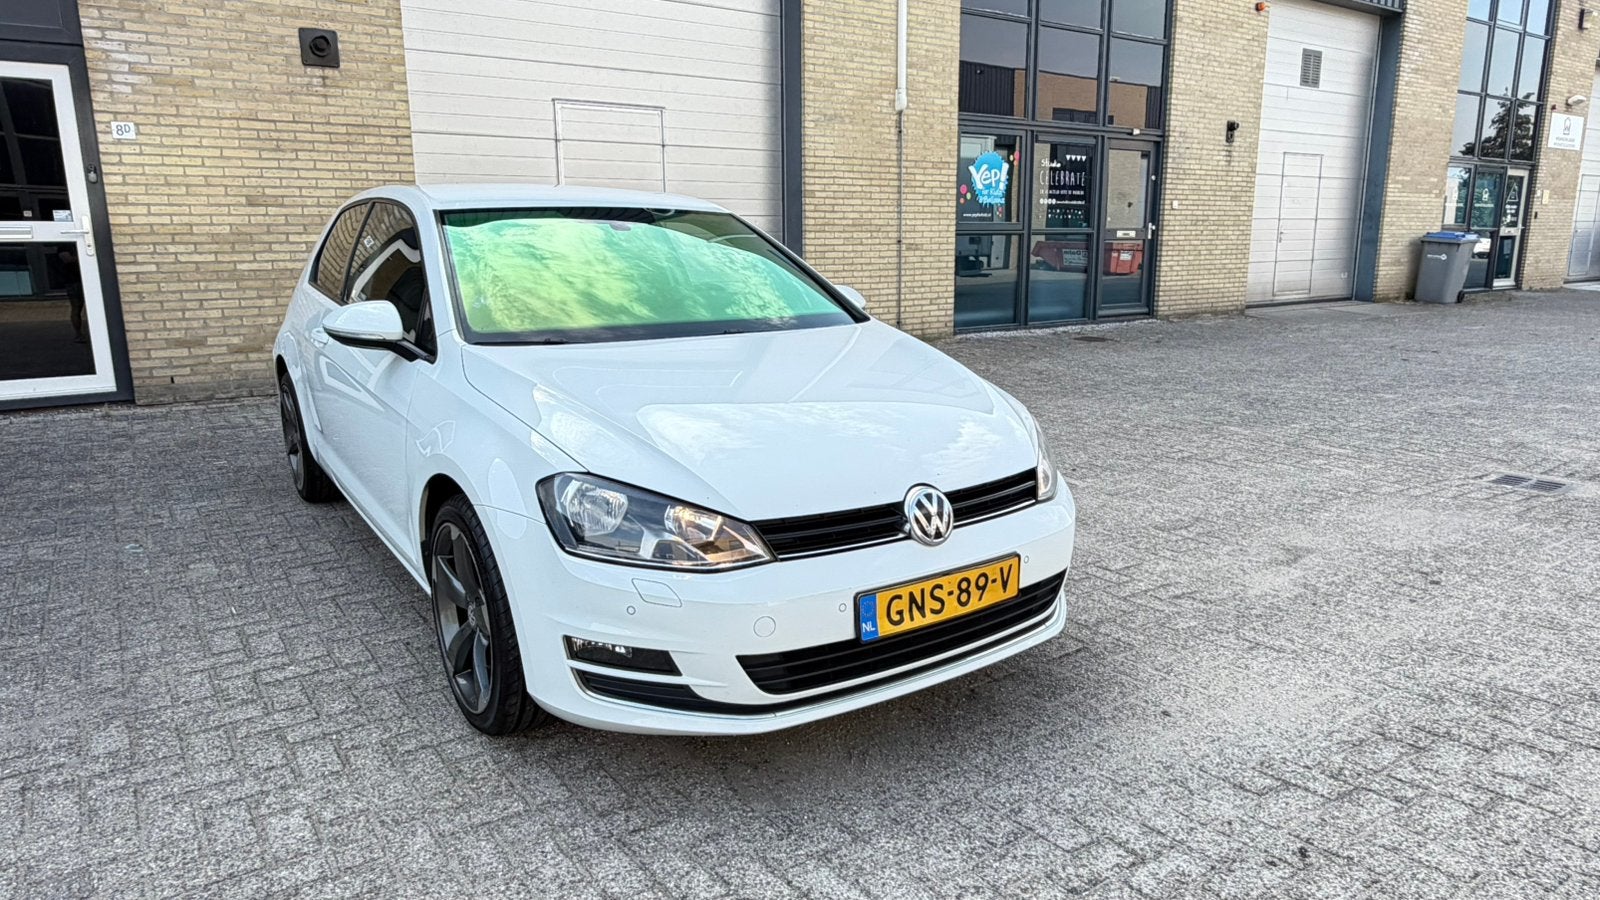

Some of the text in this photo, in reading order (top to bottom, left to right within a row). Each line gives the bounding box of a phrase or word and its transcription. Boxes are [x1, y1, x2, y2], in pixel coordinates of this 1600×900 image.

[116, 124, 131, 136] 8D
[1040, 157, 1062, 168] Studio
[968, 162, 1009, 190] Yep!
[1039, 170, 1086, 187] CELEBRATE
[886, 563, 1013, 627] GNS-89-V
[862, 620, 877, 633] NL
